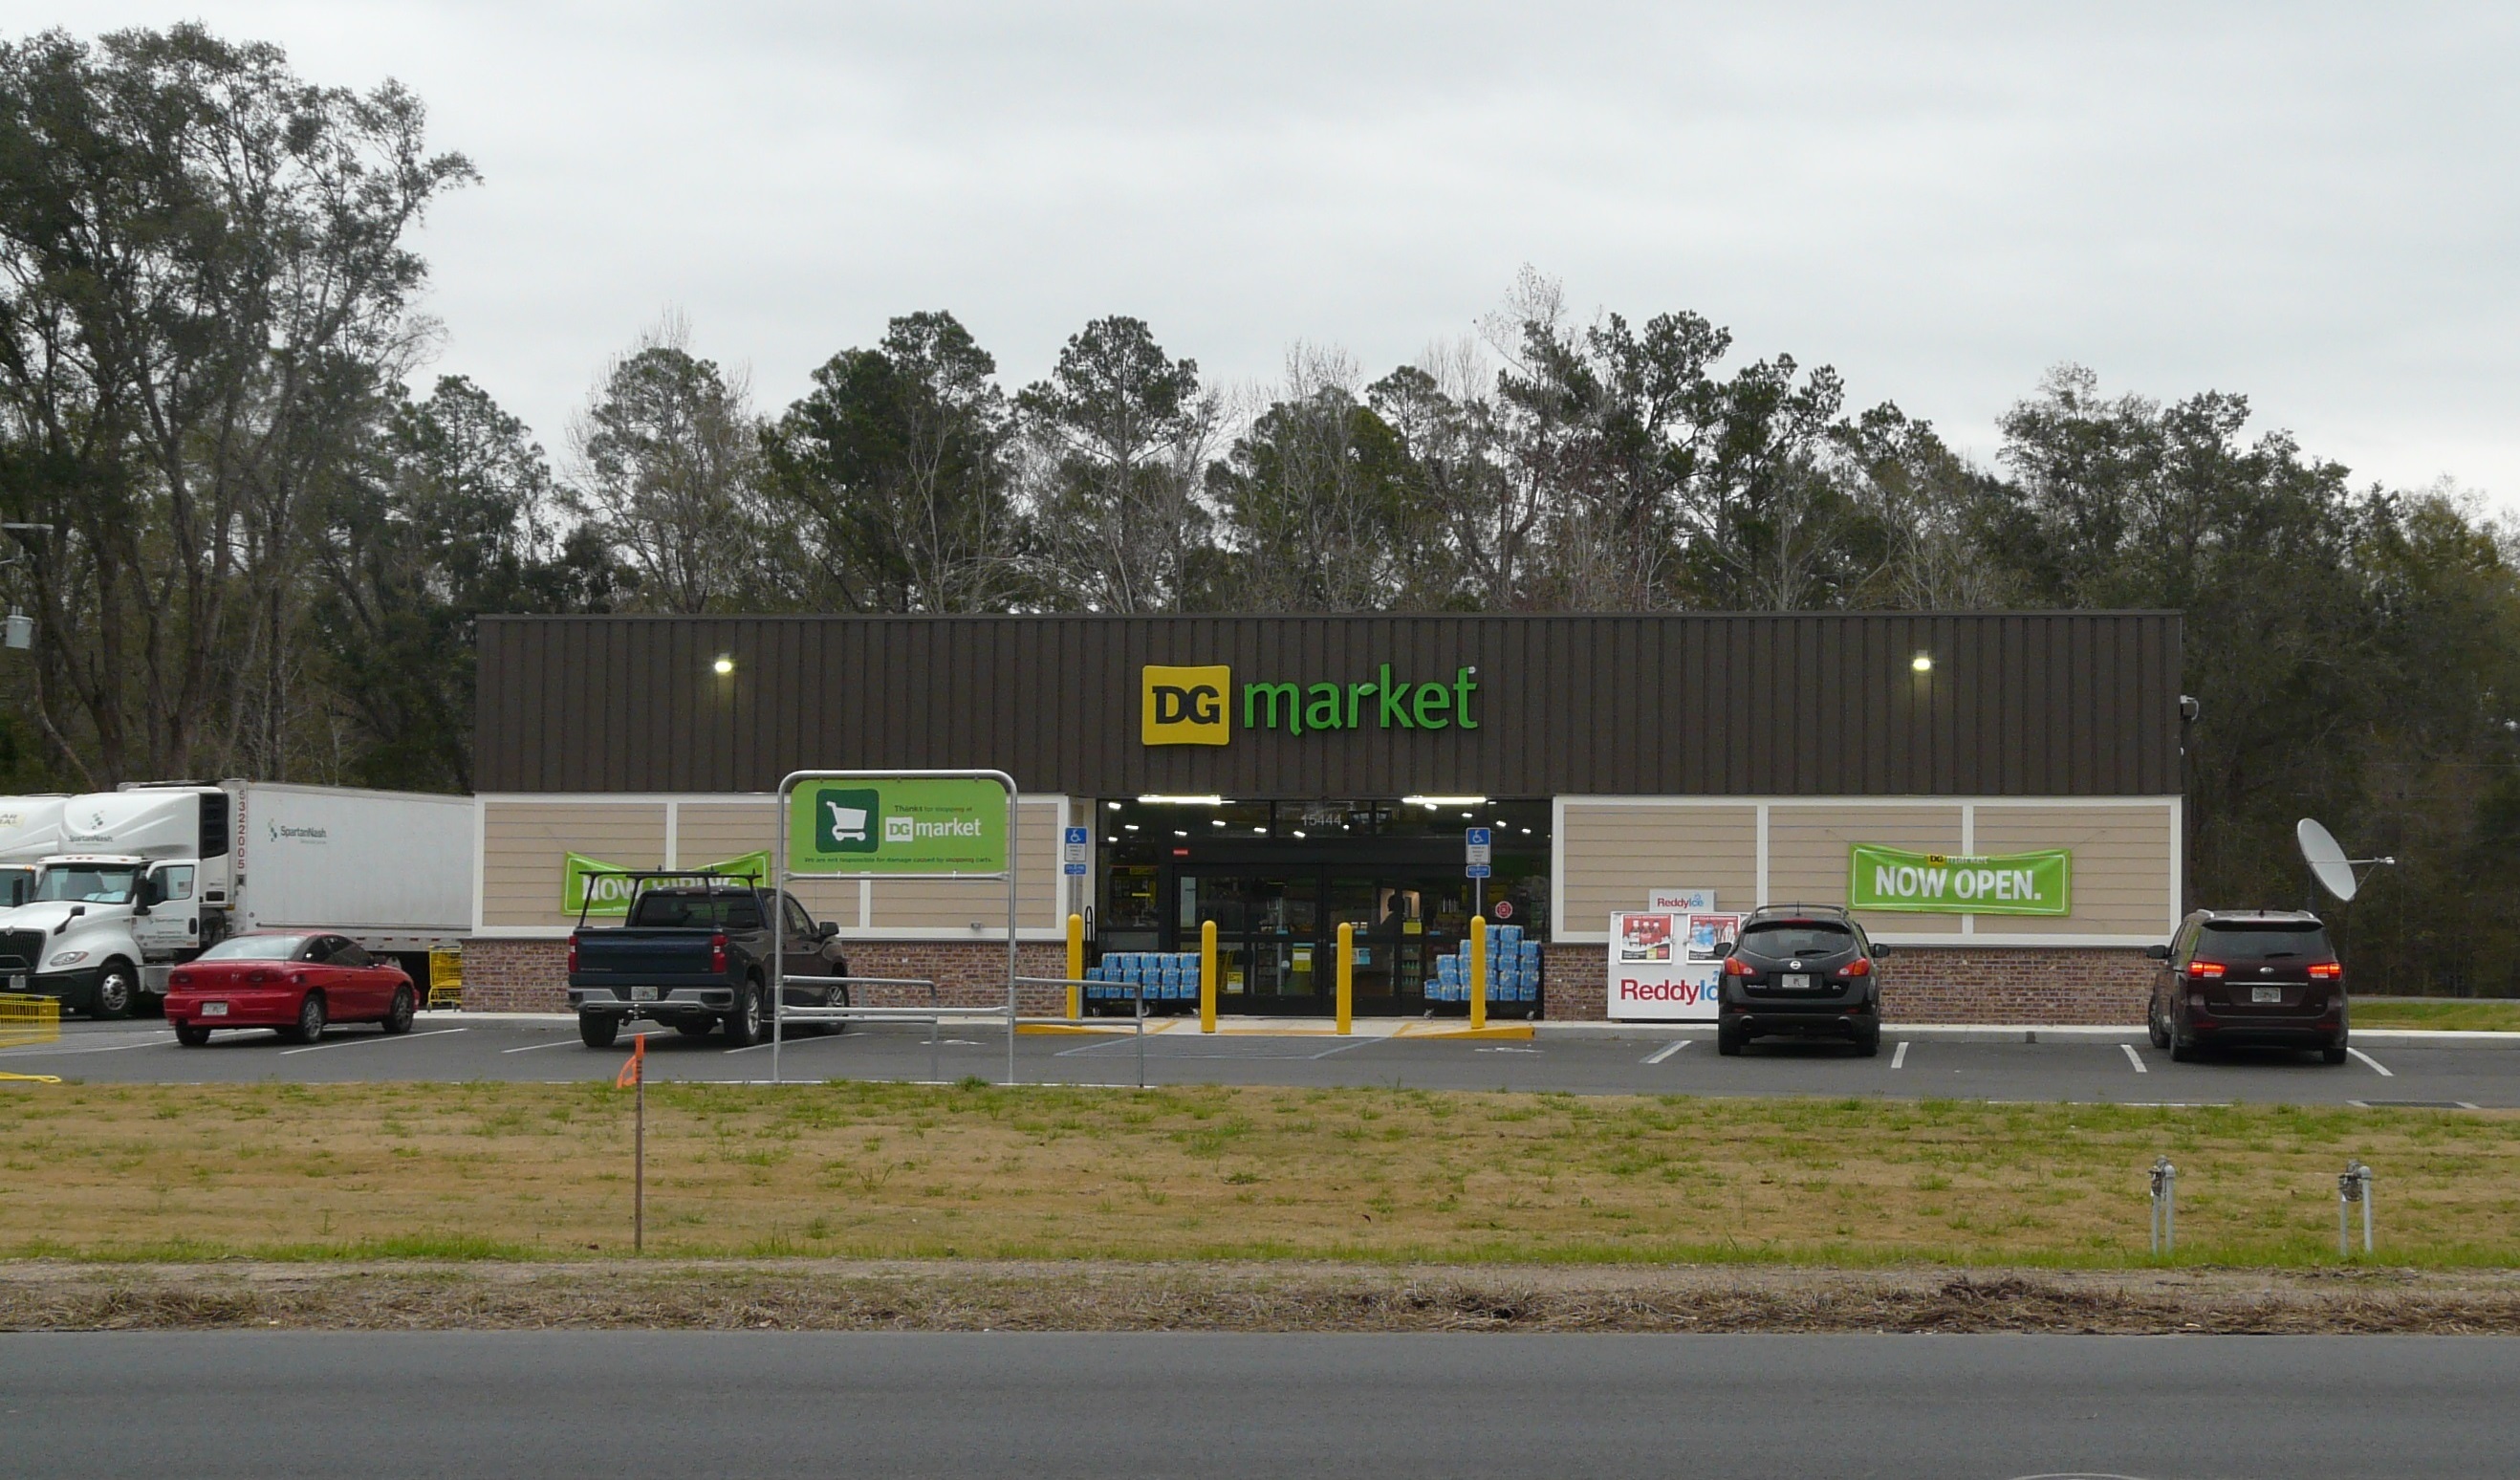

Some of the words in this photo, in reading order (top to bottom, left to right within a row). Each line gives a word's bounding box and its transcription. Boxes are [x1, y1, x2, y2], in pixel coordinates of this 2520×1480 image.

[1152, 685, 1220, 725] DG
[1244, 663, 1479, 736] market
[888, 823, 911, 836] DG
[915, 816, 983, 838] market
[1301, 813, 1342, 827] 15444
[280, 825, 327, 838] SpartanNash
[1930, 855, 1944, 863] DG
[1876, 865, 1947, 898] NOW
[1954, 869, 2042, 901] OPEN.
[1620, 978, 1719, 1006] ReddyIc
